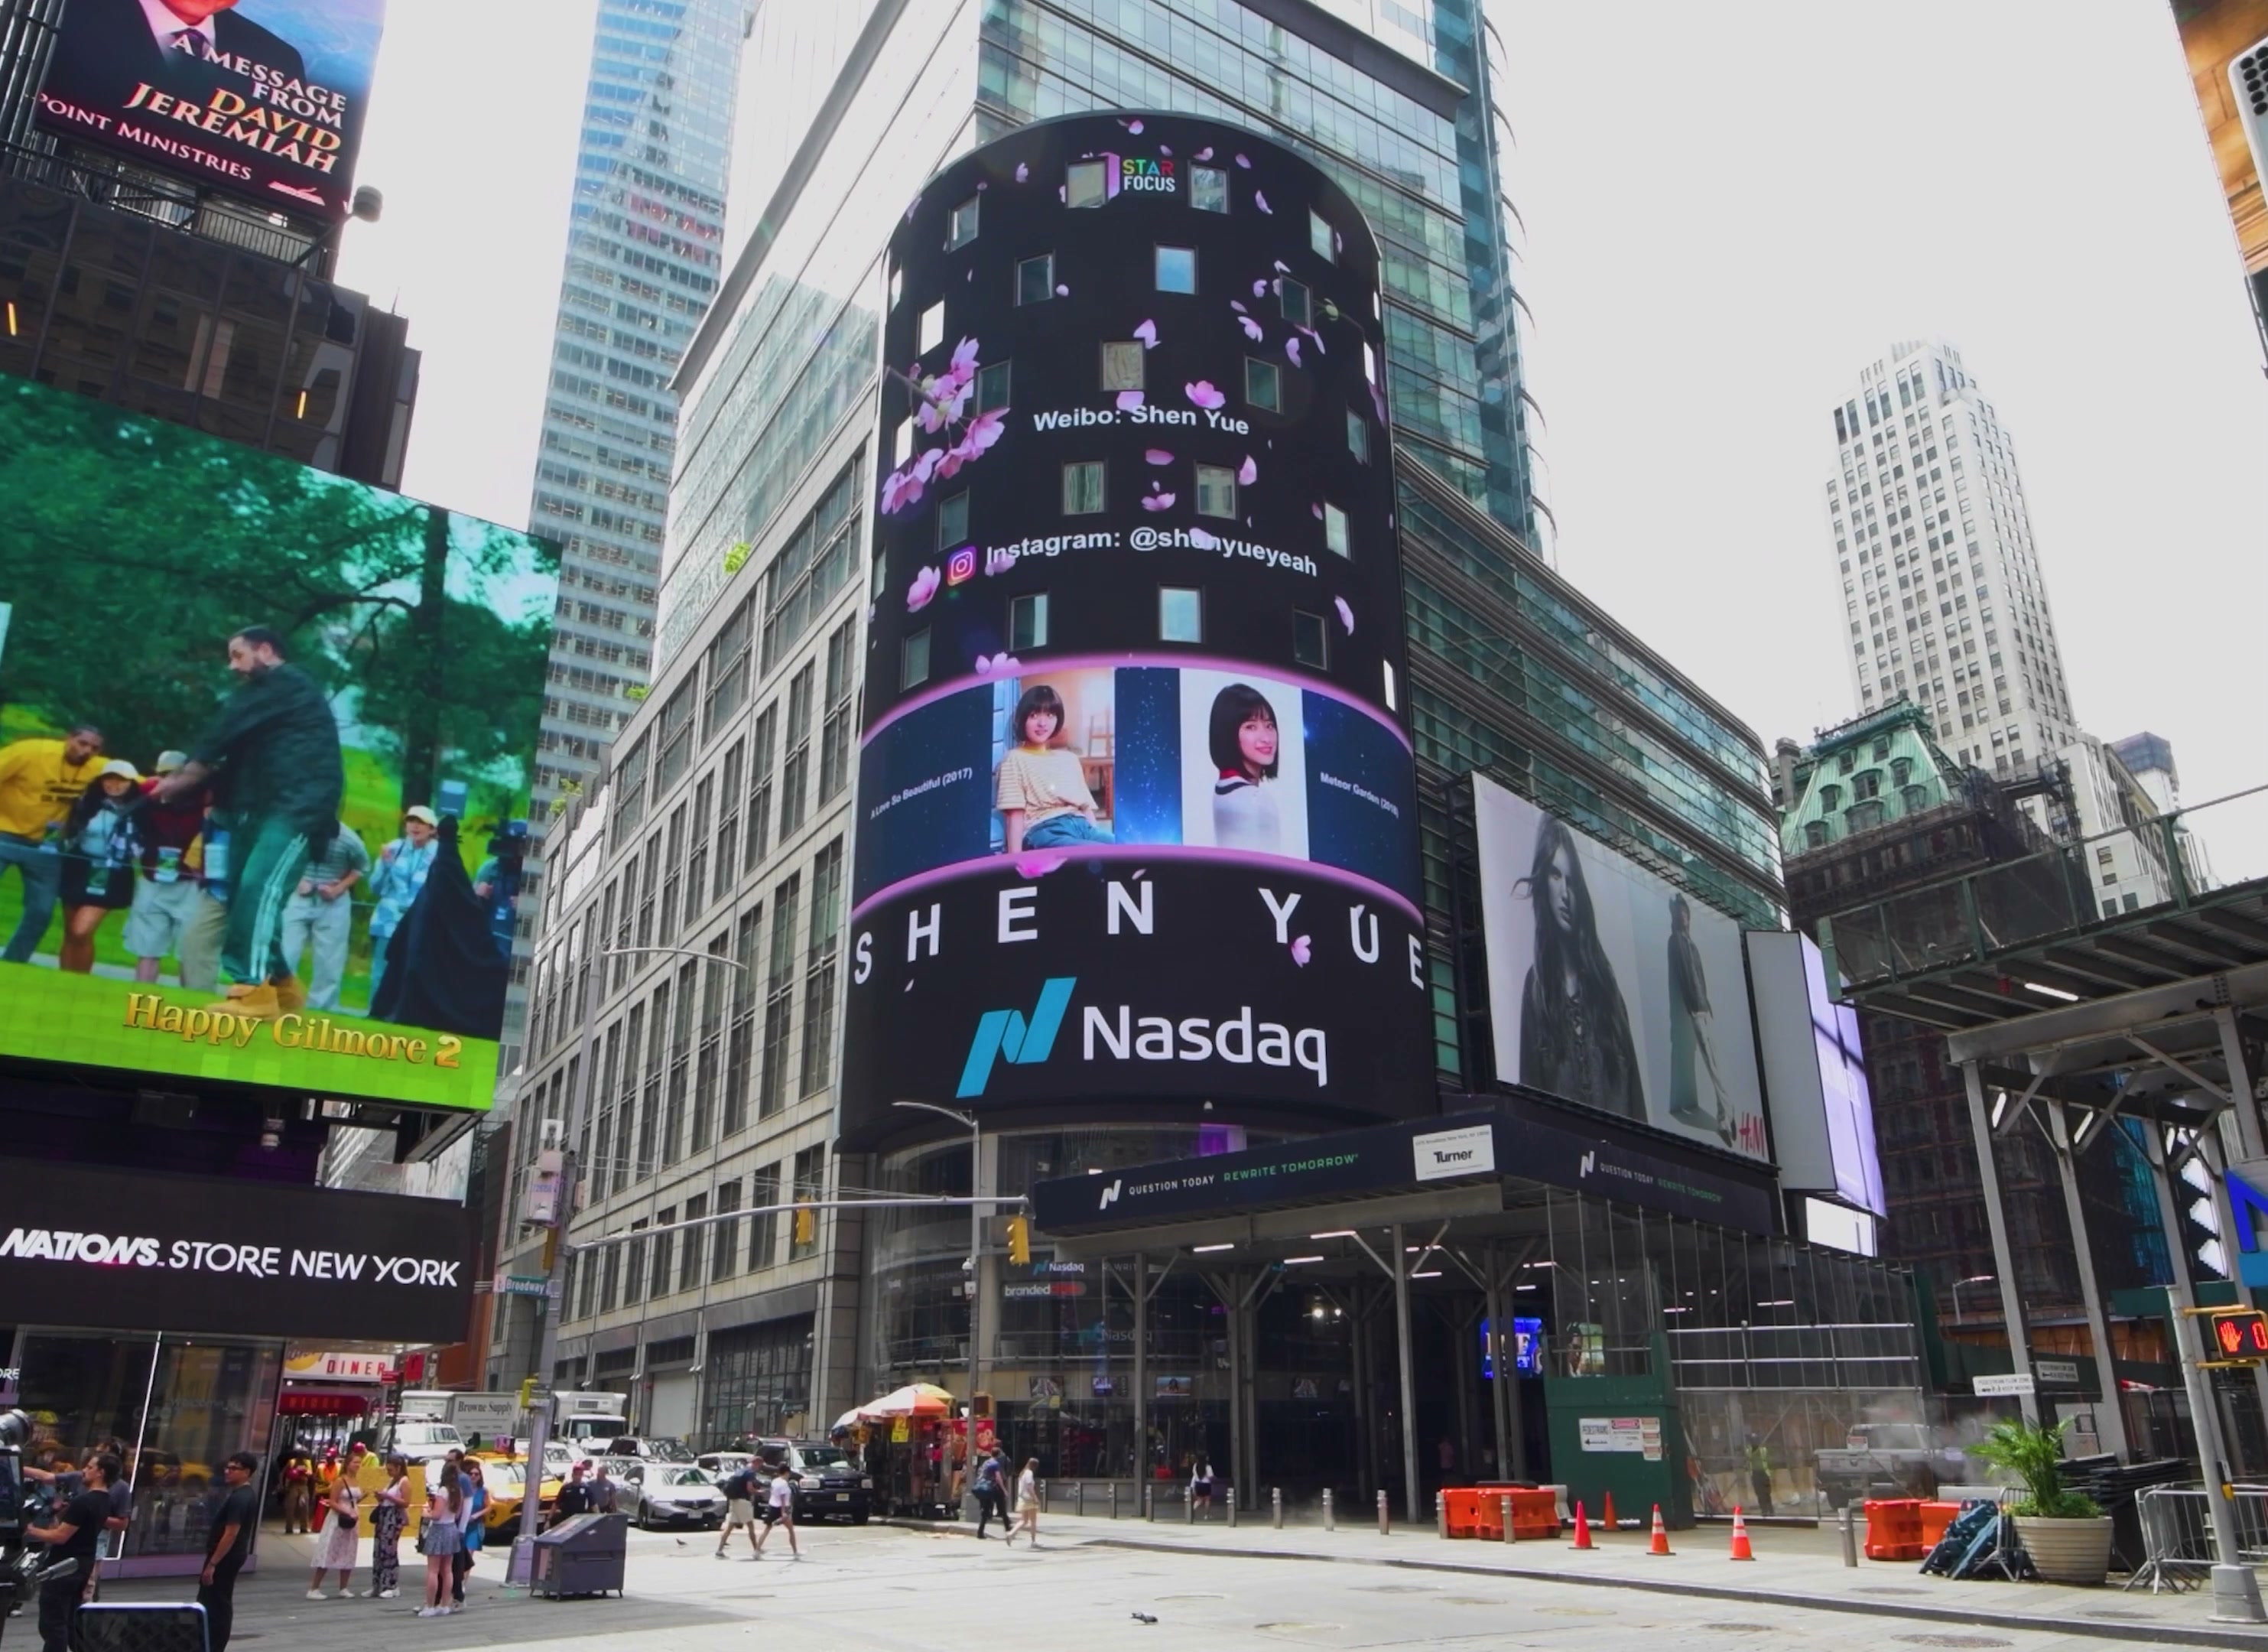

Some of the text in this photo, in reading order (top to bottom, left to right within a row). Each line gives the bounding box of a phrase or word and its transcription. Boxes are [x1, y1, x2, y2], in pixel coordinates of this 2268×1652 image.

[170, 34, 347, 112] A MESSAGE
[207, 88, 342, 151] DAVID
[252, 81, 343, 129] FROM
[122, 83, 340, 174] JEREMIAH
[117, 122, 252, 180] MINISTRIES
[1123, 159, 1175, 176] STAR
[1123, 175, 1175, 192] FOCUS
[1034, 405, 1249, 434] Weibo: Shen Yue
[986, 531, 1121, 567] Instagram:
[892, 795, 902, 805] So
[902, 776, 941, 801] Beautiful
[942, 767, 973, 787] (2017)
[1320, 771, 1352, 792] Meteor
[1353, 783, 1380, 805] Garden
[123, 993, 463, 1069] Happy Gilmore 2
[1083, 1006, 1327, 1088] Nasdaq
[1433, 1150, 1474, 1163] Turner
[1129, 1181, 1178, 1195] QUESTION
[1182, 1175, 1215, 1188] TODAY
[1223, 1166, 1277, 1182] REWRITE
[1600, 1162, 1633, 1179] QUESTION
[1634, 1172, 1654, 1185] TODAY
[169, 1240, 281, 1278] STORE
[290, 1249, 367, 1280] NEW
[372, 1255, 461, 1287] YORK
[1049, 1262, 1085, 1273] Nasdaq
[505, 1277, 545, 1295] Broadway
[1004, 1283, 1051, 1296] branded
[327, 1359, 386, 1376] DINER
[458, 1400, 513, 1414] Browne Supply
